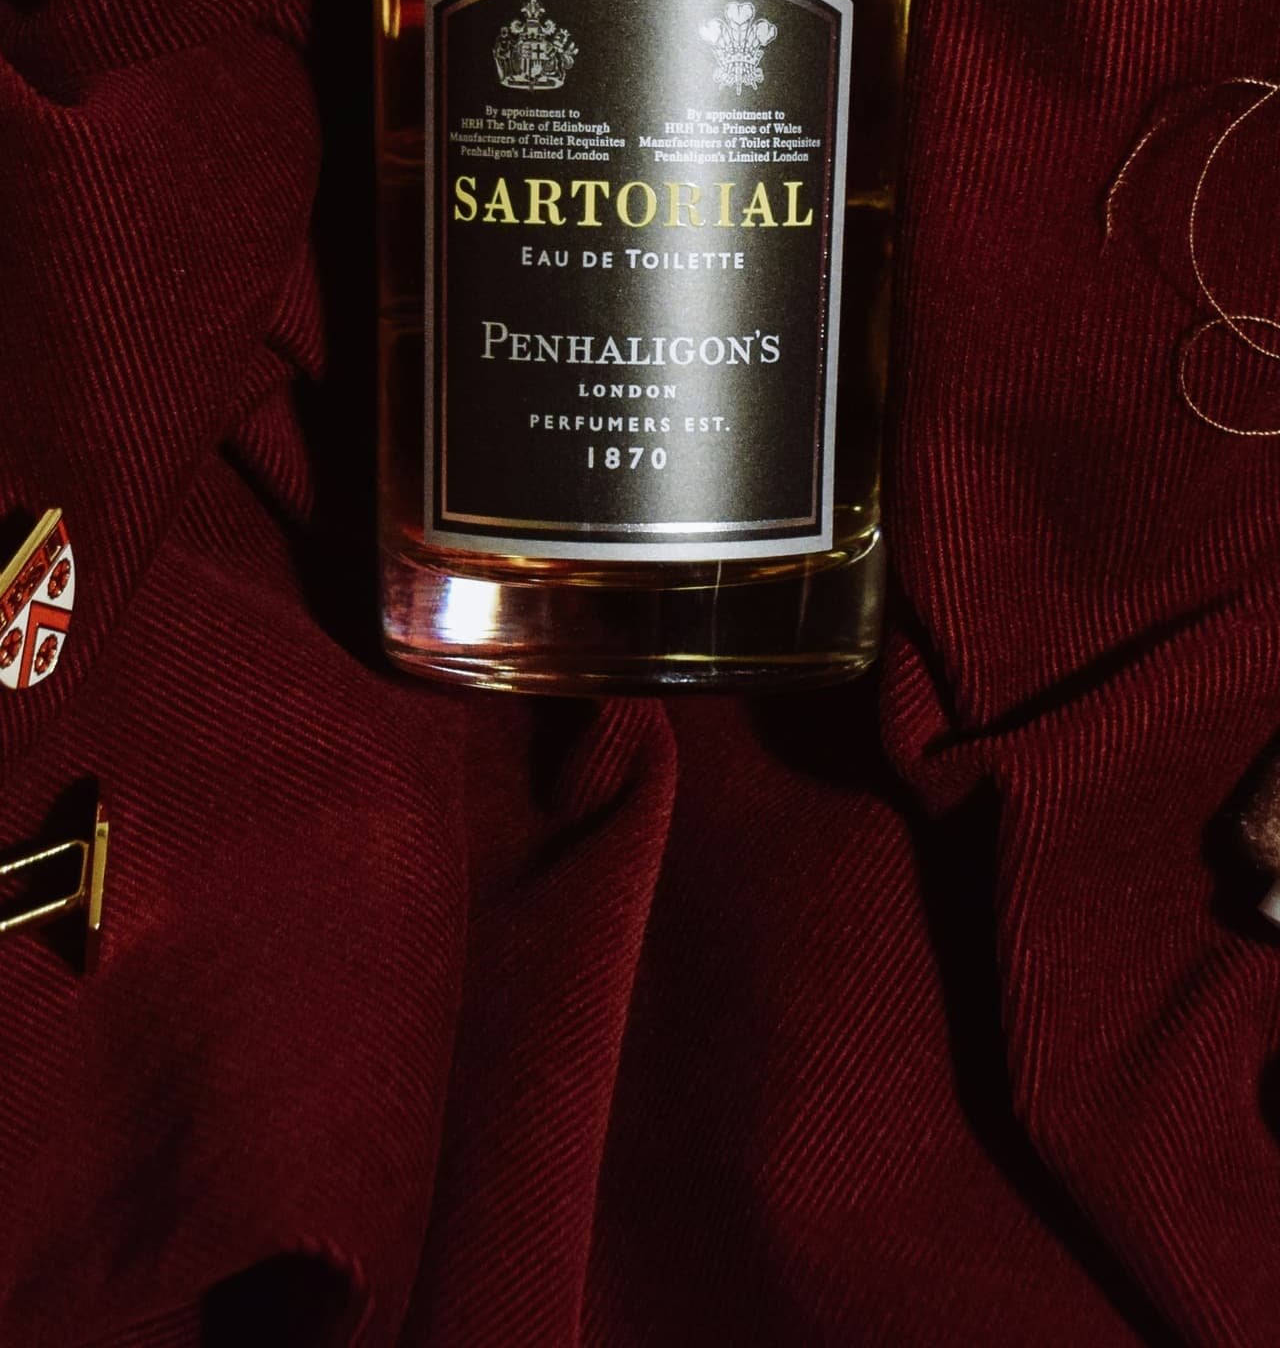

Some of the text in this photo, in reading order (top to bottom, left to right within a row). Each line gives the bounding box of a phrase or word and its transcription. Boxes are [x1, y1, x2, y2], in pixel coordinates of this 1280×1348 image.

[485, 105, 580, 119] By appointment to
[687, 109, 784, 122] By appointment to
[461, 119, 610, 135] HRH The Duke of Edinburgh
[665, 124, 802, 133] HRH The Prince of Wales
[450, 132, 625, 148] Manufacturers of Toilet Requisites
[639, 137, 820, 149] Manufacturers of Toilet Requisites
[461, 146, 609, 161] Penhaligon's Limited London
[655, 151, 808, 164] Penhaligon's Limited London
[453, 175, 814, 229] SARTORIAL
[521, 247, 745, 270] EAU DE TOILETTE
[481, 321, 781, 366] PENHALIGON'S
[578, 383, 677, 398] LONDON
[530, 415, 731, 433] PERFUMERS EST.
[586, 447, 668, 470] 1870
